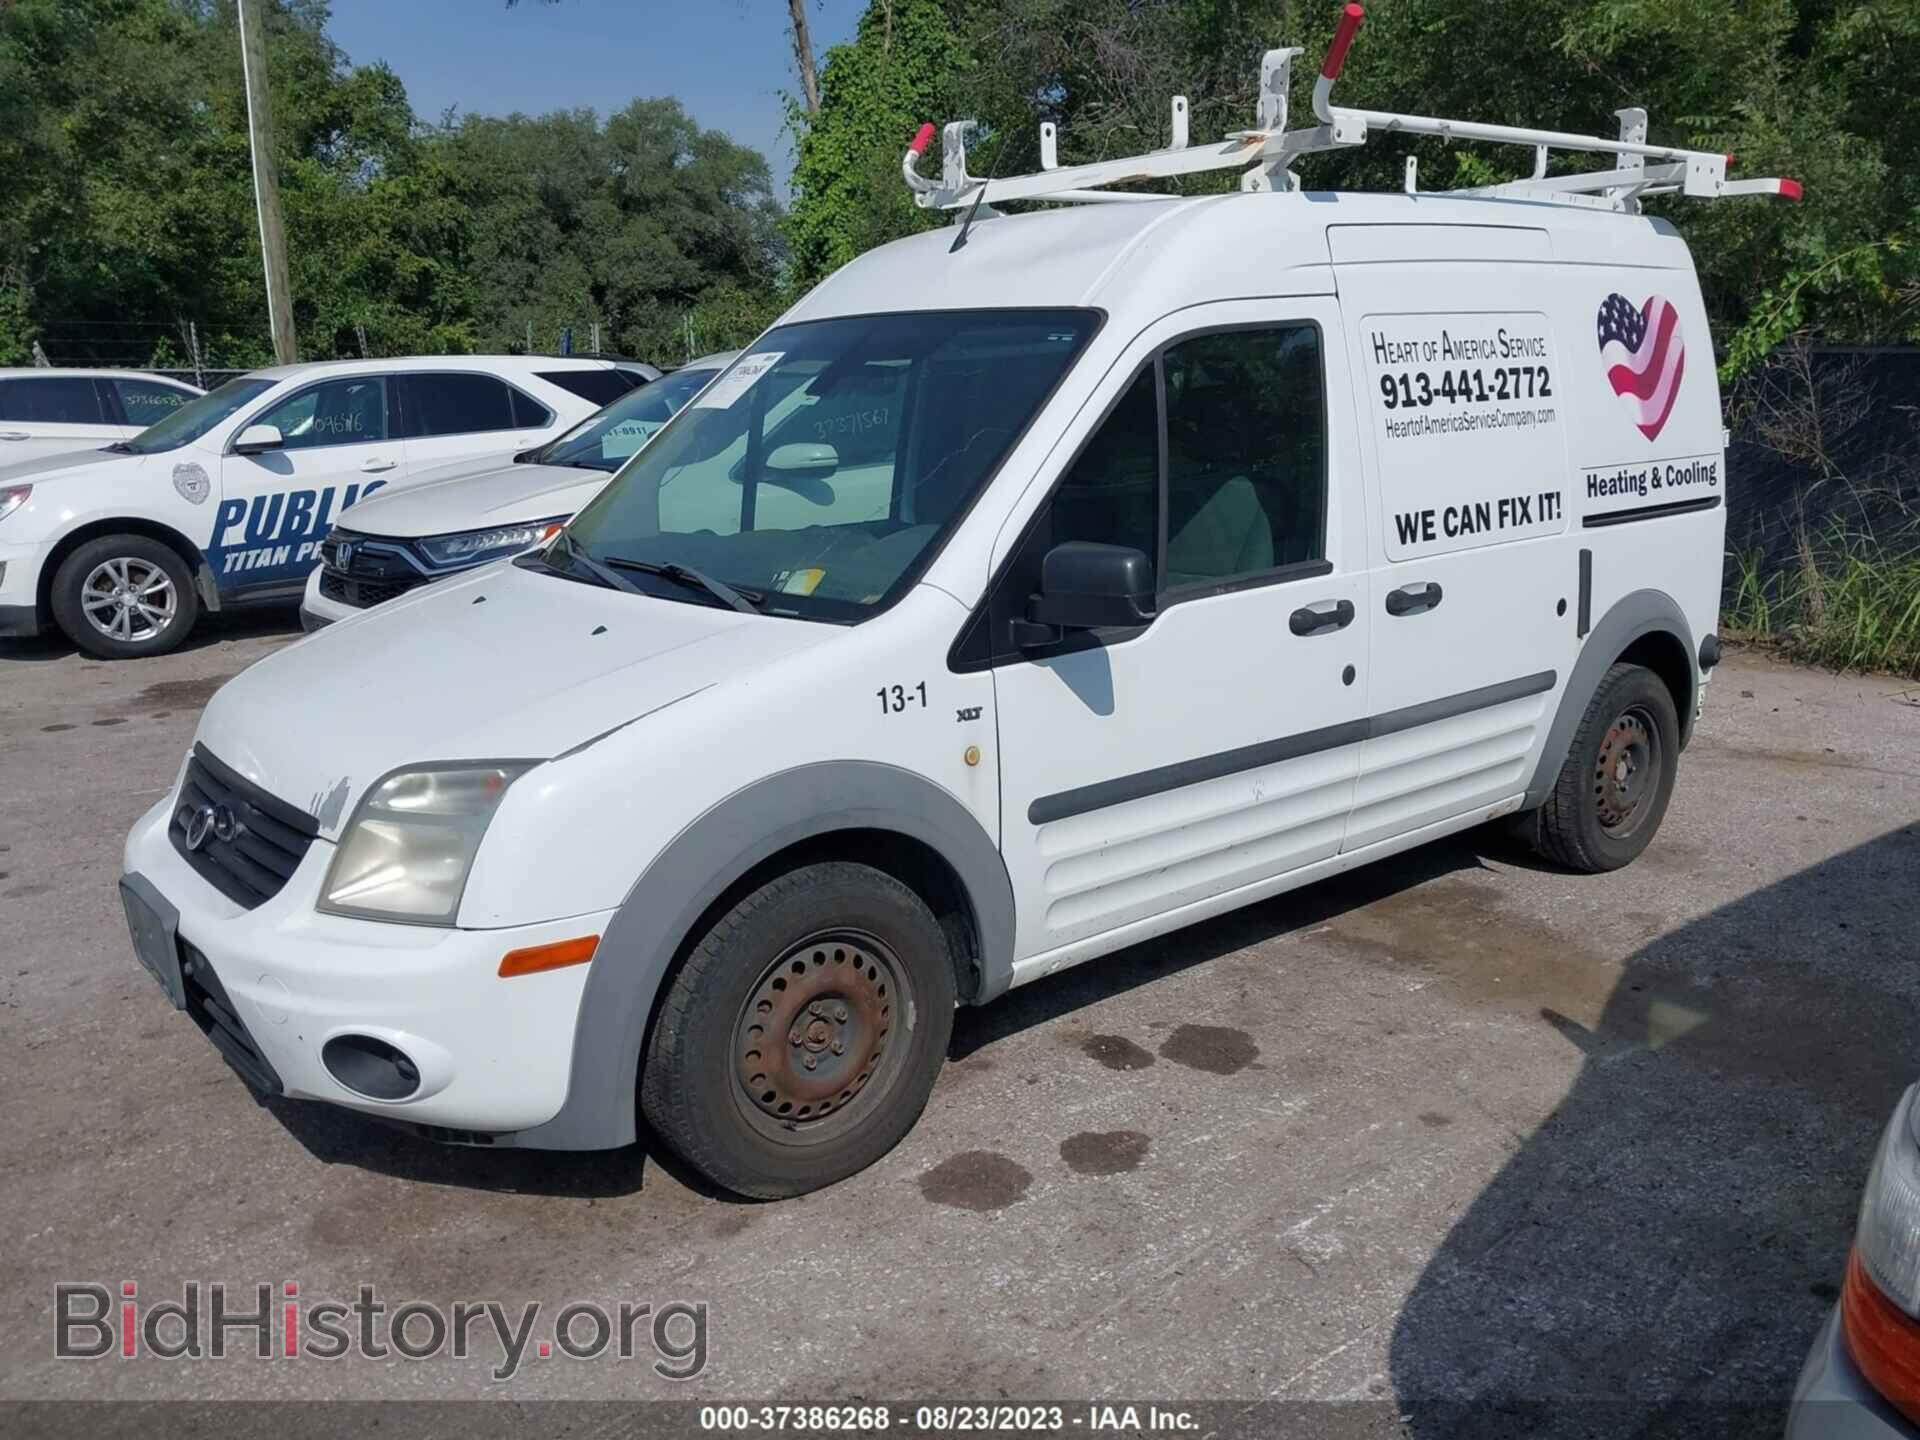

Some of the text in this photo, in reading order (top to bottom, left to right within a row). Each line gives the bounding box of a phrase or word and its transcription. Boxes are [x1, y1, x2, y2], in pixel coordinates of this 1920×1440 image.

[1380, 366, 1552, 409] 913-441-2772
[1385, 408, 1556, 439] HeartofAmericaServiceCompany.com
[1586, 461, 1718, 498] Heating & Cooling
[208, 480, 388, 549] PUBLI
[1394, 491, 1562, 545] WE CAN FIX IT!
[223, 545, 292, 573] TITAN
[876, 680, 927, 714] 13-1
[956, 706, 983, 723] XLT
